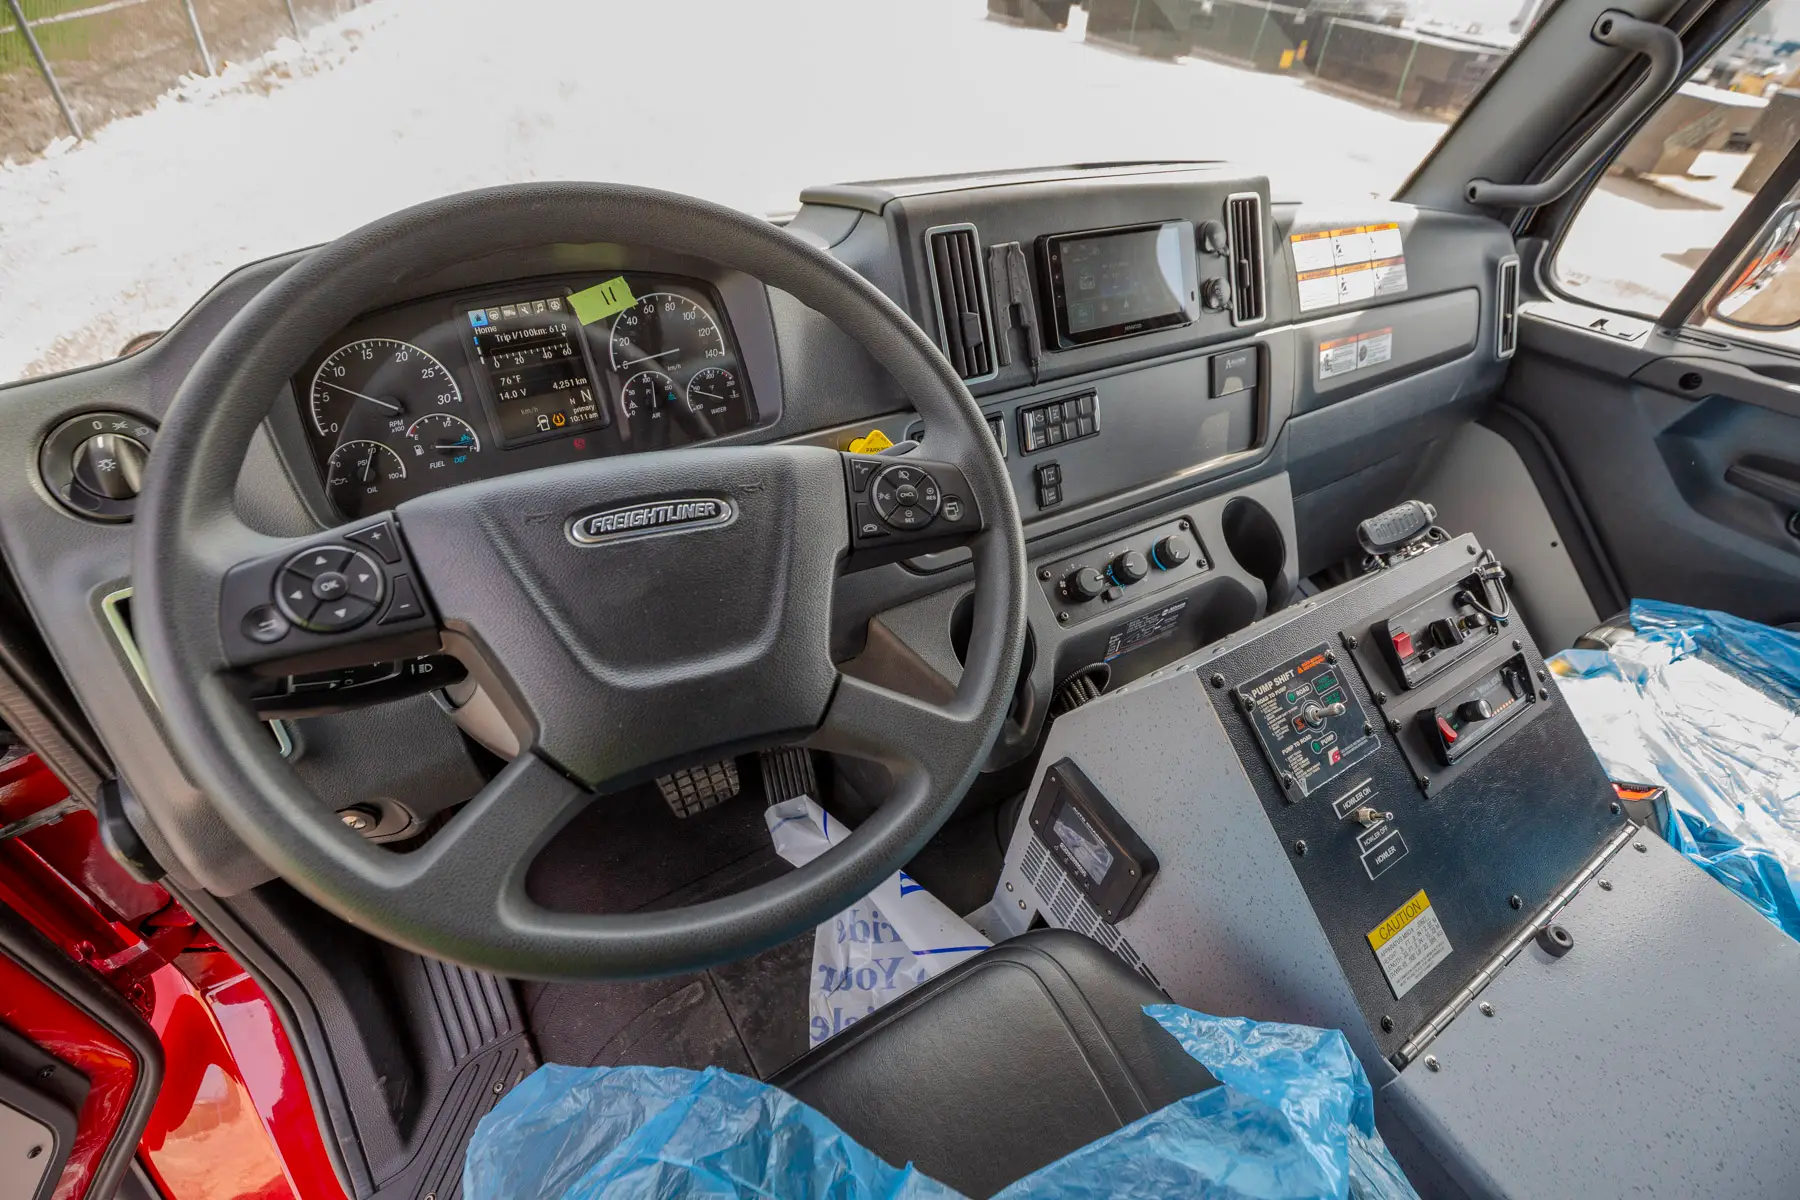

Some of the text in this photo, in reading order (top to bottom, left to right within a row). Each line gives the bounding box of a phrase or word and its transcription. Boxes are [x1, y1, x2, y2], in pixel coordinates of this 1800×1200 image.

[644, 304, 654, 314] 60
[665, 302, 676, 312] 80
[626, 316, 638, 326] 40
[682, 311, 696, 321] 100
[474, 326, 498, 336] Home
[495, 333, 512, 343] Trip
[548, 324, 567, 334] 61.0
[698, 328, 711, 337] 120
[619, 336, 630, 347] 20
[361, 349, 373, 360] 15
[395, 351, 408, 362] 20
[514, 356, 524, 364] 20
[542, 351, 552, 360] 40
[562, 348, 572, 356] 60
[704, 348, 718, 358] 140
[333, 367, 346, 378] 10
[667, 363, 682, 372] km/h
[422, 368, 435, 379] 25
[574, 378, 588, 386] km
[322, 392, 330, 402] 5
[437, 394, 451, 405] 30
[500, 390, 518, 400] 14.0
[580, 389, 592, 402] N
[520, 407, 538, 415] km/h
[573, 404, 594, 414] primary
[710, 406, 727, 414] WATER
[570, 414, 588, 422] 10:11
[330, 422, 338, 434] 0
[389, 420, 404, 428] RPM
[392, 426, 405, 434] x100
[454, 455, 467, 464] DEF
[430, 461, 446, 470] FUEL
[590, 502, 716, 534] FREIGHTLINER
[320, 580, 340, 592] OK
[1252, 670, 1296, 698] PUMP SHIFT
[1296, 685, 1310, 696] ROAD
[1320, 734, 1334, 746] PUMP
[1342, 786, 1372, 810] HOWLER ON
[1363, 825, 1388, 846] HOWLER OFF
[1375, 845, 1396, 864] HOWLER
[1379, 900, 1422, 940] CAUTION
